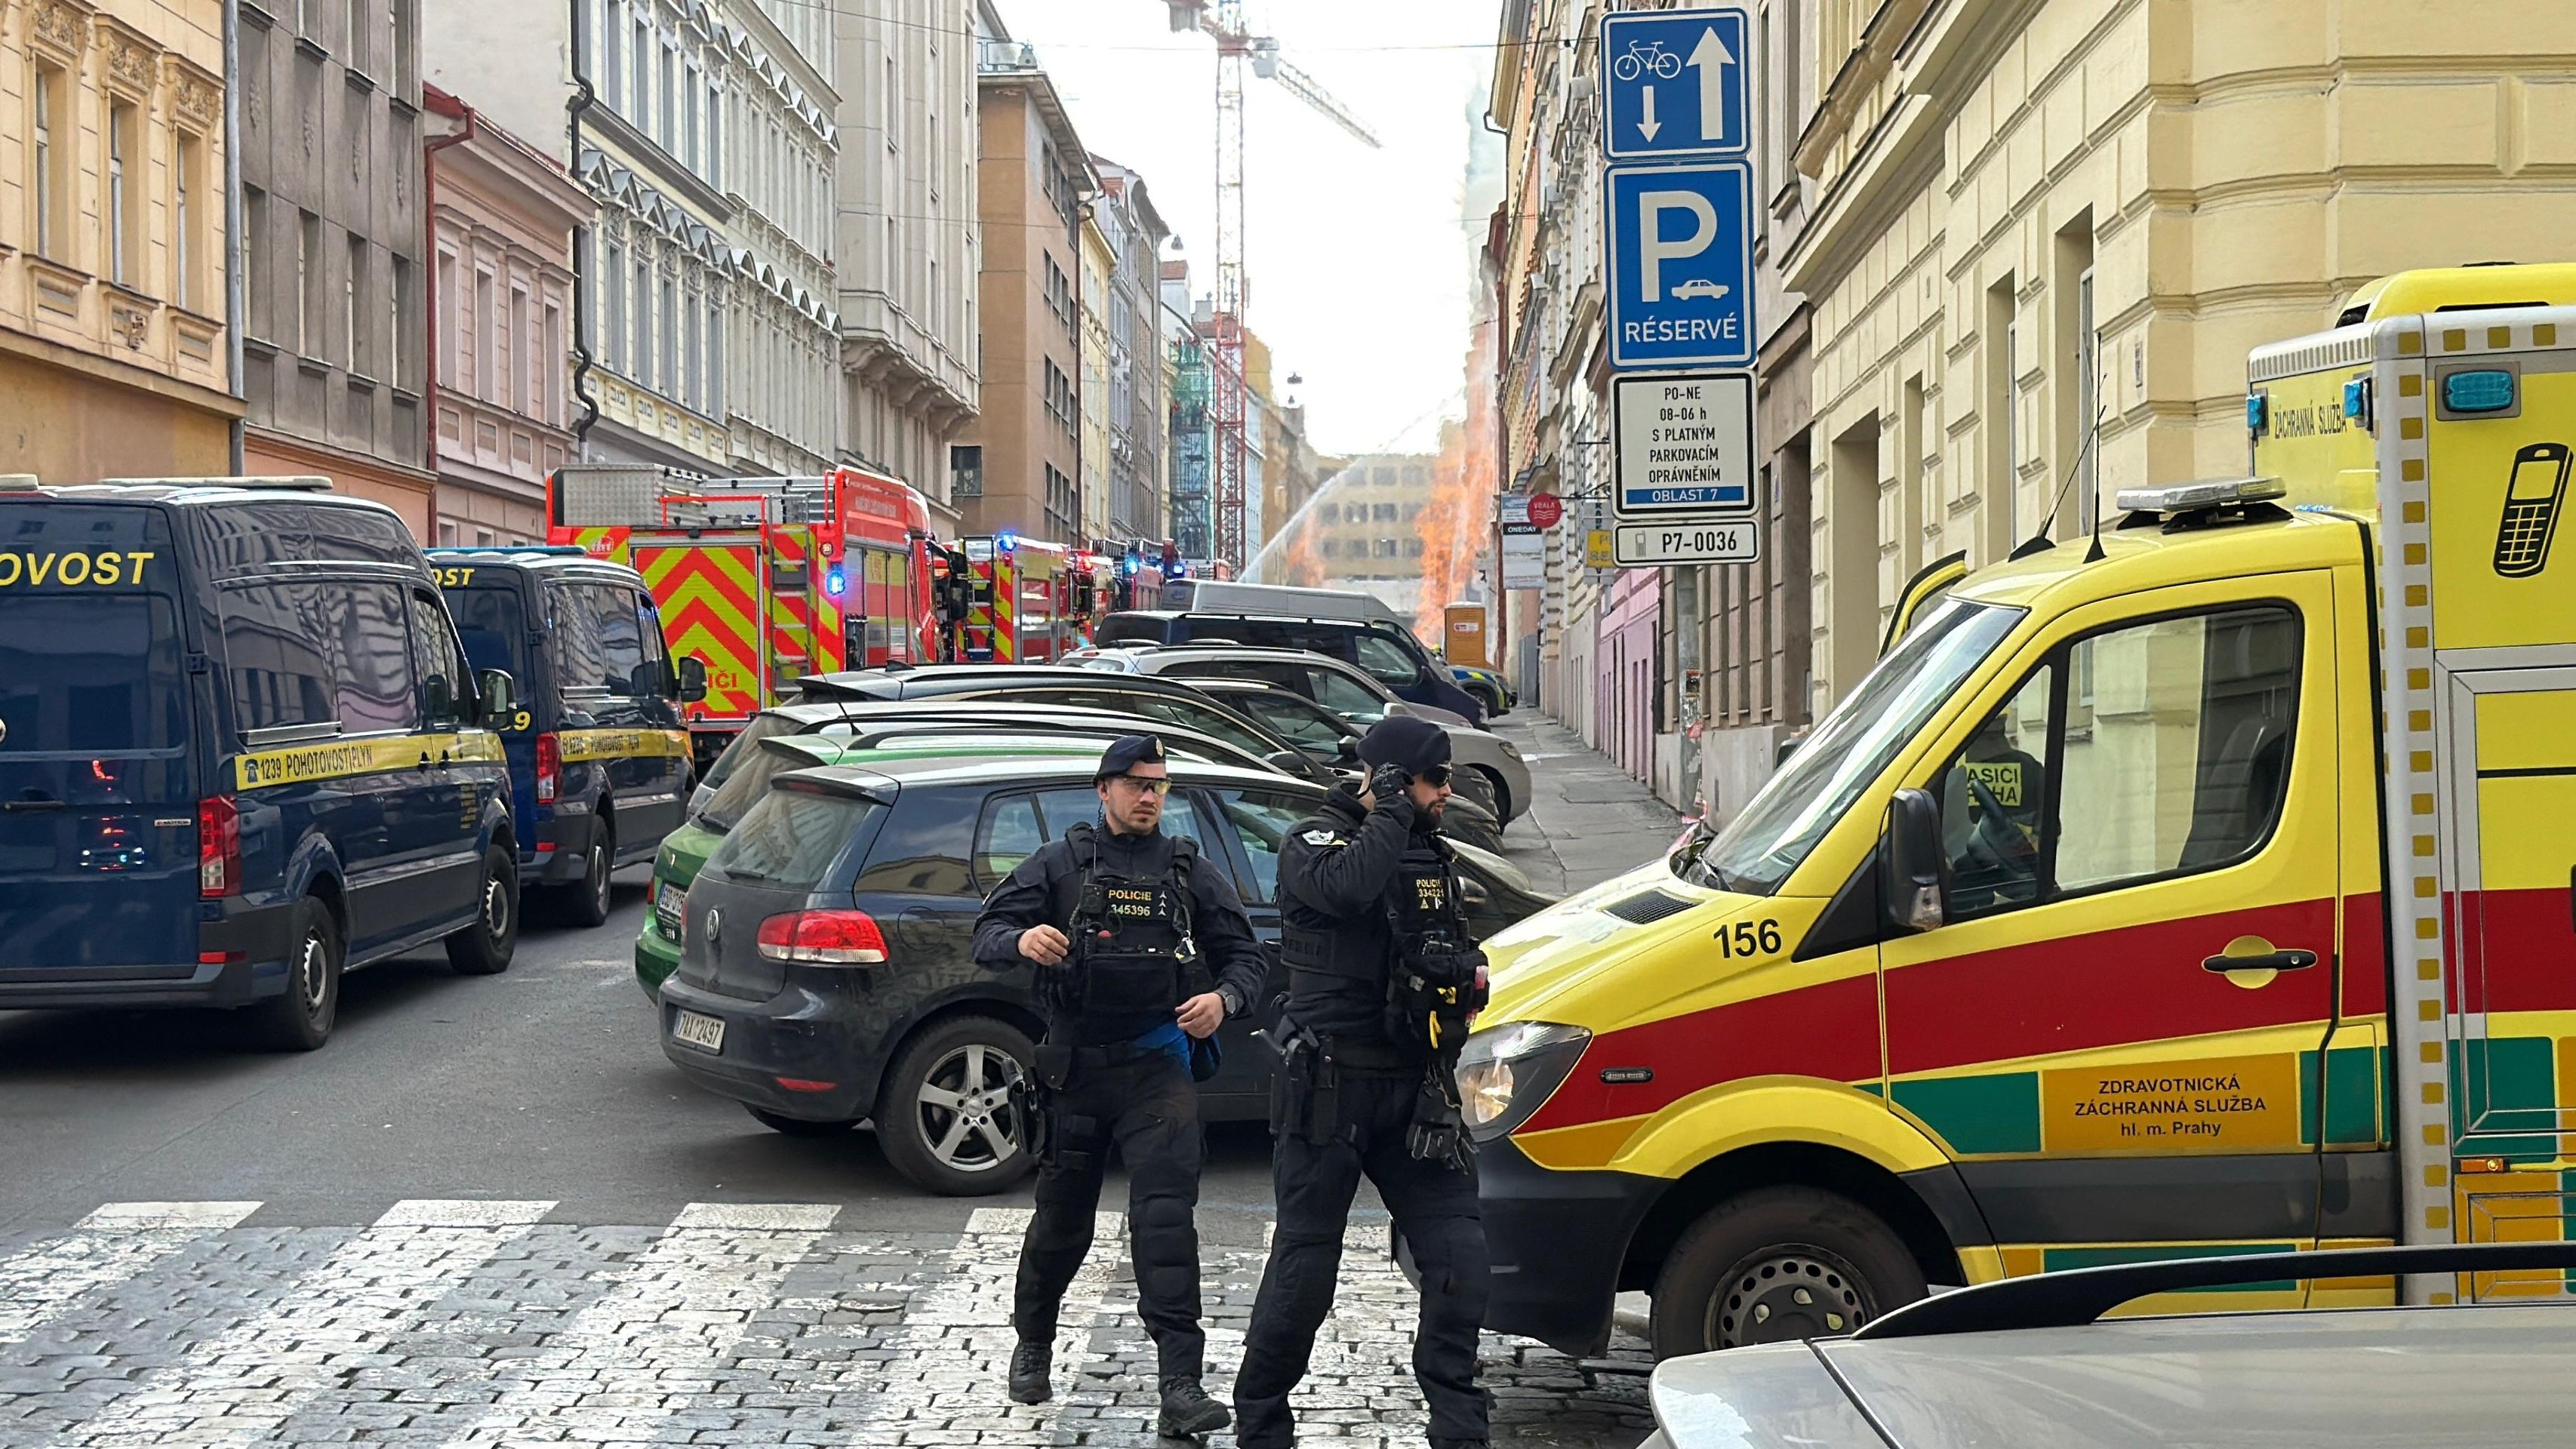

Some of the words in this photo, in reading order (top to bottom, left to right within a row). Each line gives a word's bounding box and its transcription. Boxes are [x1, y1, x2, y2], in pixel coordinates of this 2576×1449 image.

[1639, 191, 1717, 302] P
[1625, 312, 1737, 343] RÉSERVÉ
[1664, 386, 1701, 400] PO-NE
[1660, 408, 1694, 420] 08-06
[1700, 408, 1707, 420] h
[2274, 399, 2316, 438] ZÁCHRANNÁ
[2319, 396, 2347, 435] SLUŽBA
[1652, 429, 1659, 441] S
[1665, 423, 1716, 441] PLATNÝM
[1649, 444, 1719, 463] PARKOVACÍM
[1648, 465, 1721, 483] OPRÁVNĚNÍM
[1652, 489, 1704, 501] OBLAST
[1710, 488, 1718, 500] 7
[1662, 531, 1737, 552] P7-0036
[0, 552, 155, 586] OVOST
[260, 758, 282, 780] 1239
[286, 747, 349, 778] POHOTOVOST
[352, 745, 373, 768] PLYN
[1108, 890, 1152, 901] POLICIE
[1111, 904, 1151, 916] 345396
[1713, 918, 1781, 958] 156
[2099, 1074, 2241, 1094] ZDRAVOTNICKÁ
[2074, 1099, 2189, 1116] ZÁCHRANNÁ
[2193, 1095, 2267, 1113] SLUŽBA
[2121, 1123, 2141, 1137] hl.
[2147, 1124, 2166, 1136] m.
[2173, 1121, 2222, 1137] Prahy
